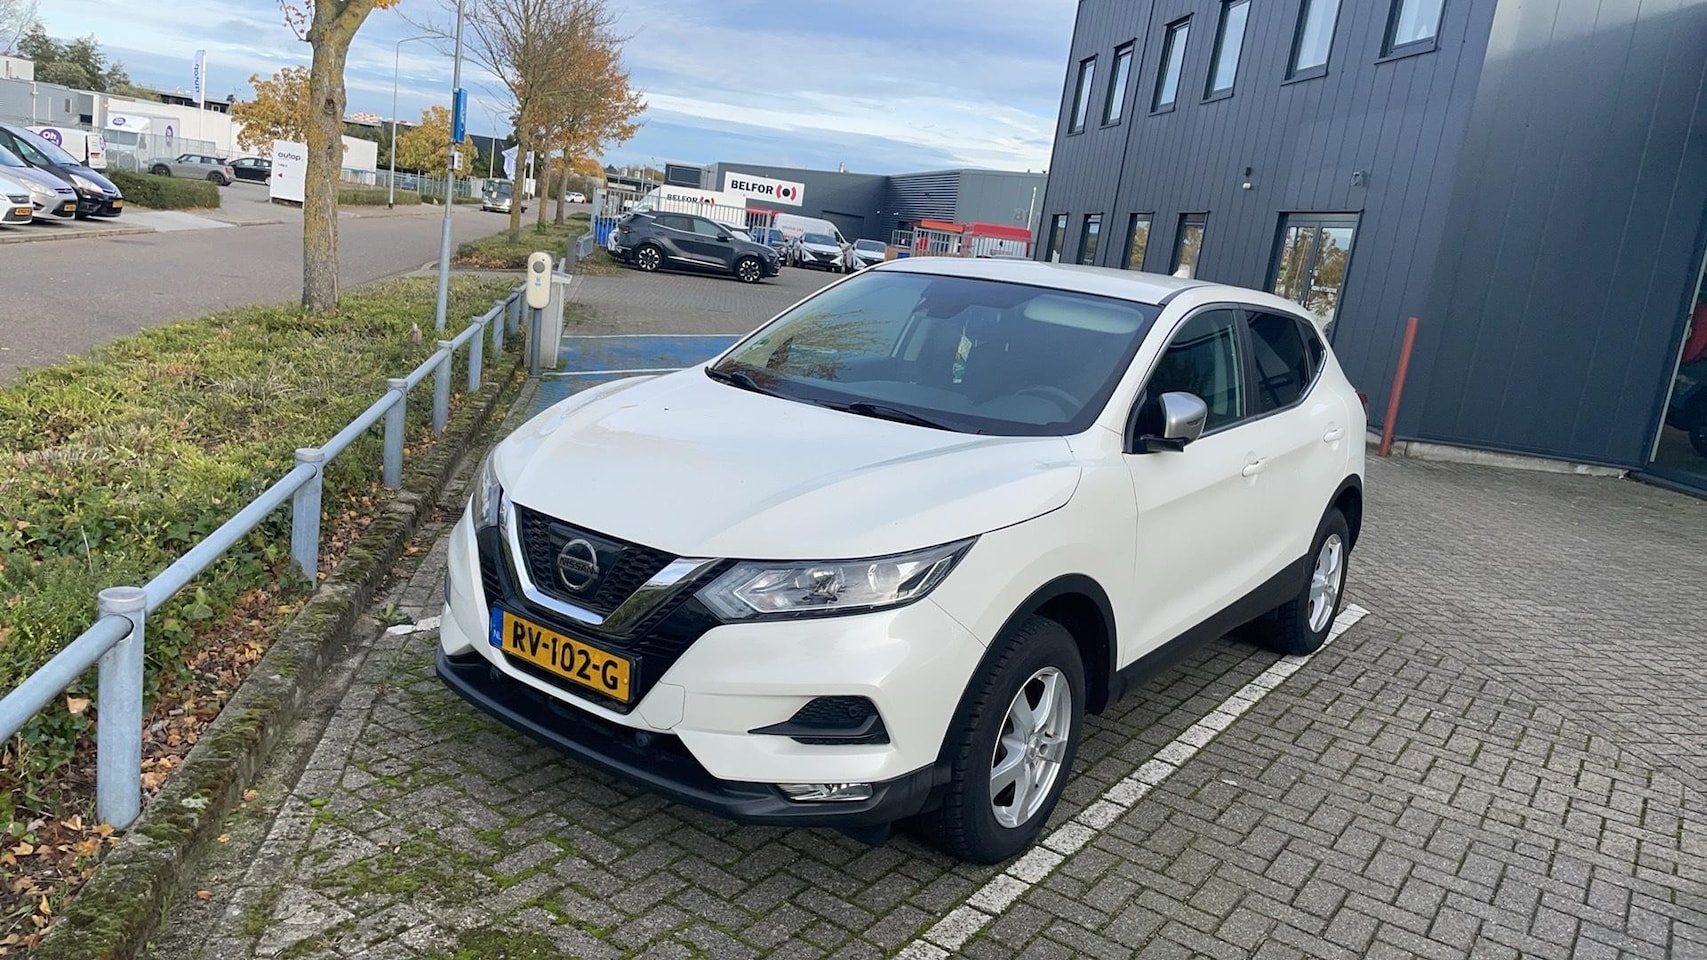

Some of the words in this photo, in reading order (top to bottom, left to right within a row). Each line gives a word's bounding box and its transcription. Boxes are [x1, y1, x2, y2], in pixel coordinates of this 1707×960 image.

[731, 180, 774, 195] BELFOR
[667, 193, 698, 204] BELFOR
[561, 557, 597, 576] NISSAN
[512, 620, 618, 690] RV-102-G
